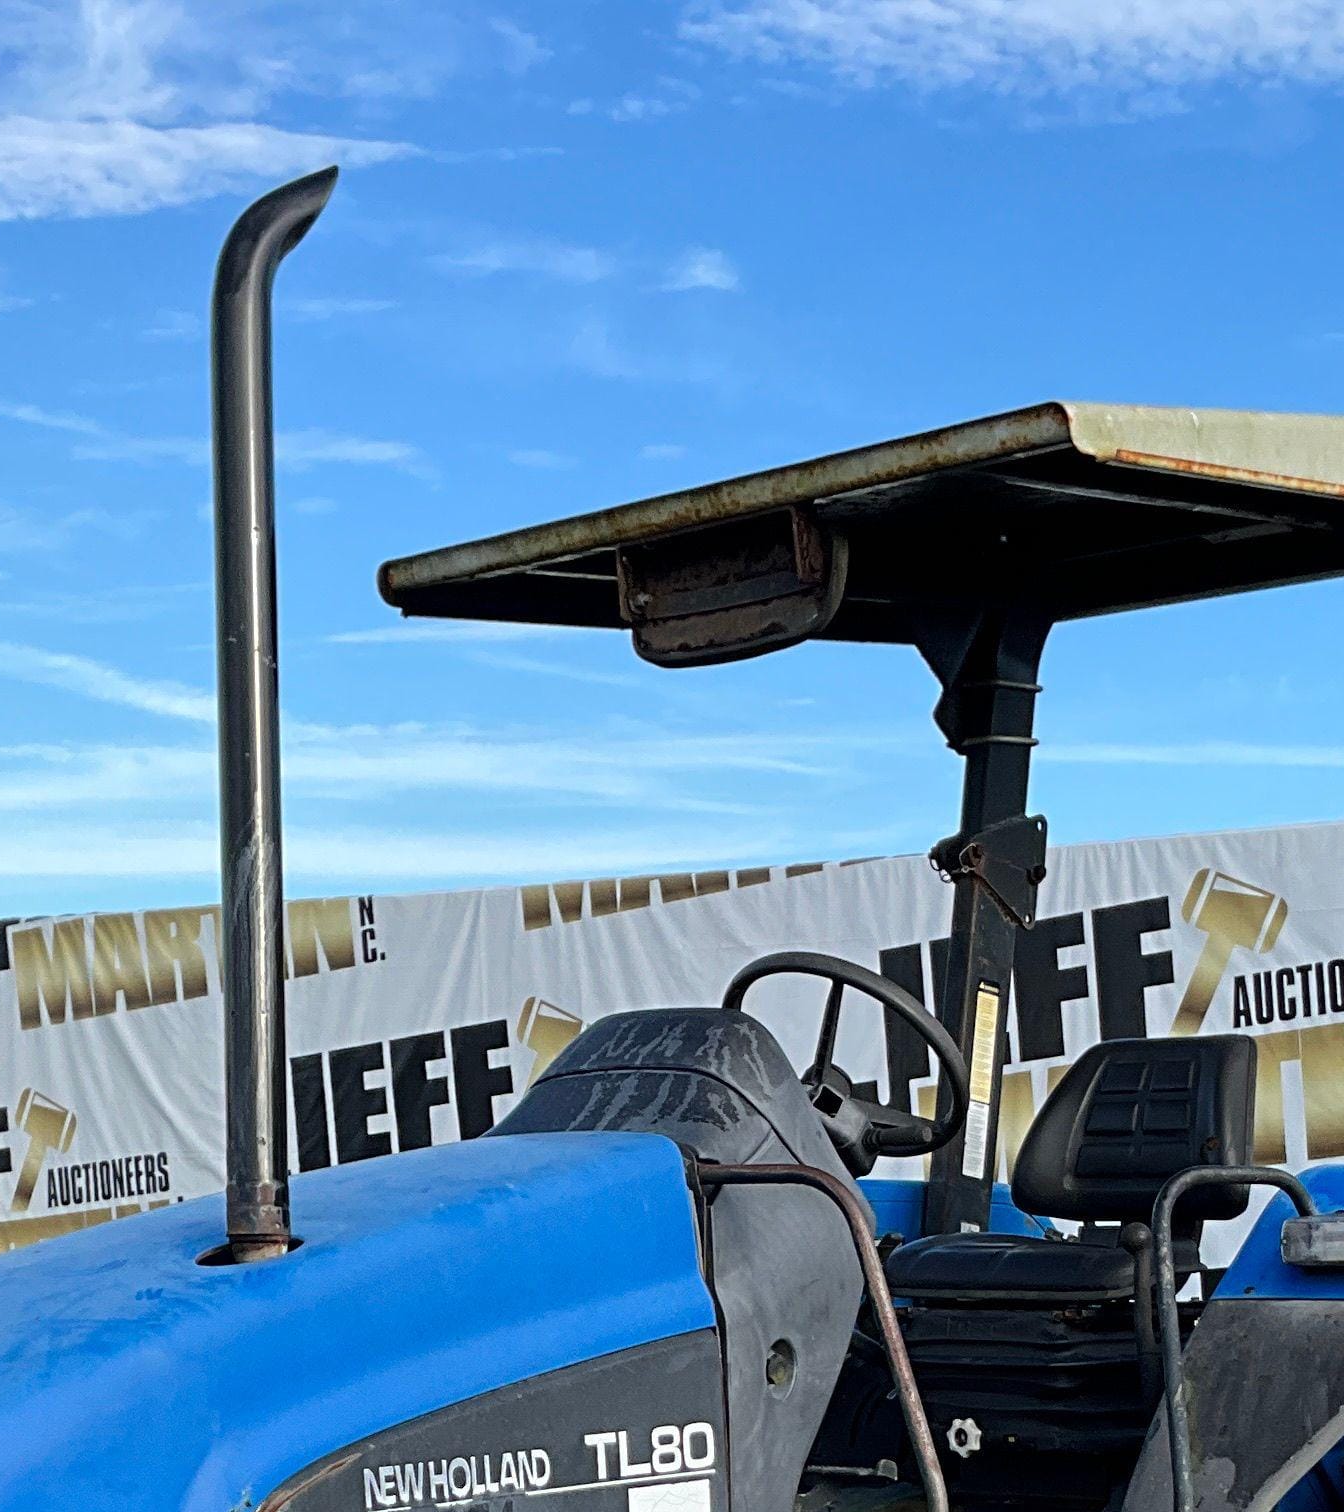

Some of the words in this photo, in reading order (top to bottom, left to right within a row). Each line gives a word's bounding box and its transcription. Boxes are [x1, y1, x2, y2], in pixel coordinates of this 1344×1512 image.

[47, 1152, 170, 1209] AUCTIONEERS
[362, 1461, 425, 1511] NEW
[429, 1447, 551, 1500] HOLLAND
[584, 1421, 716, 1480] TL80
